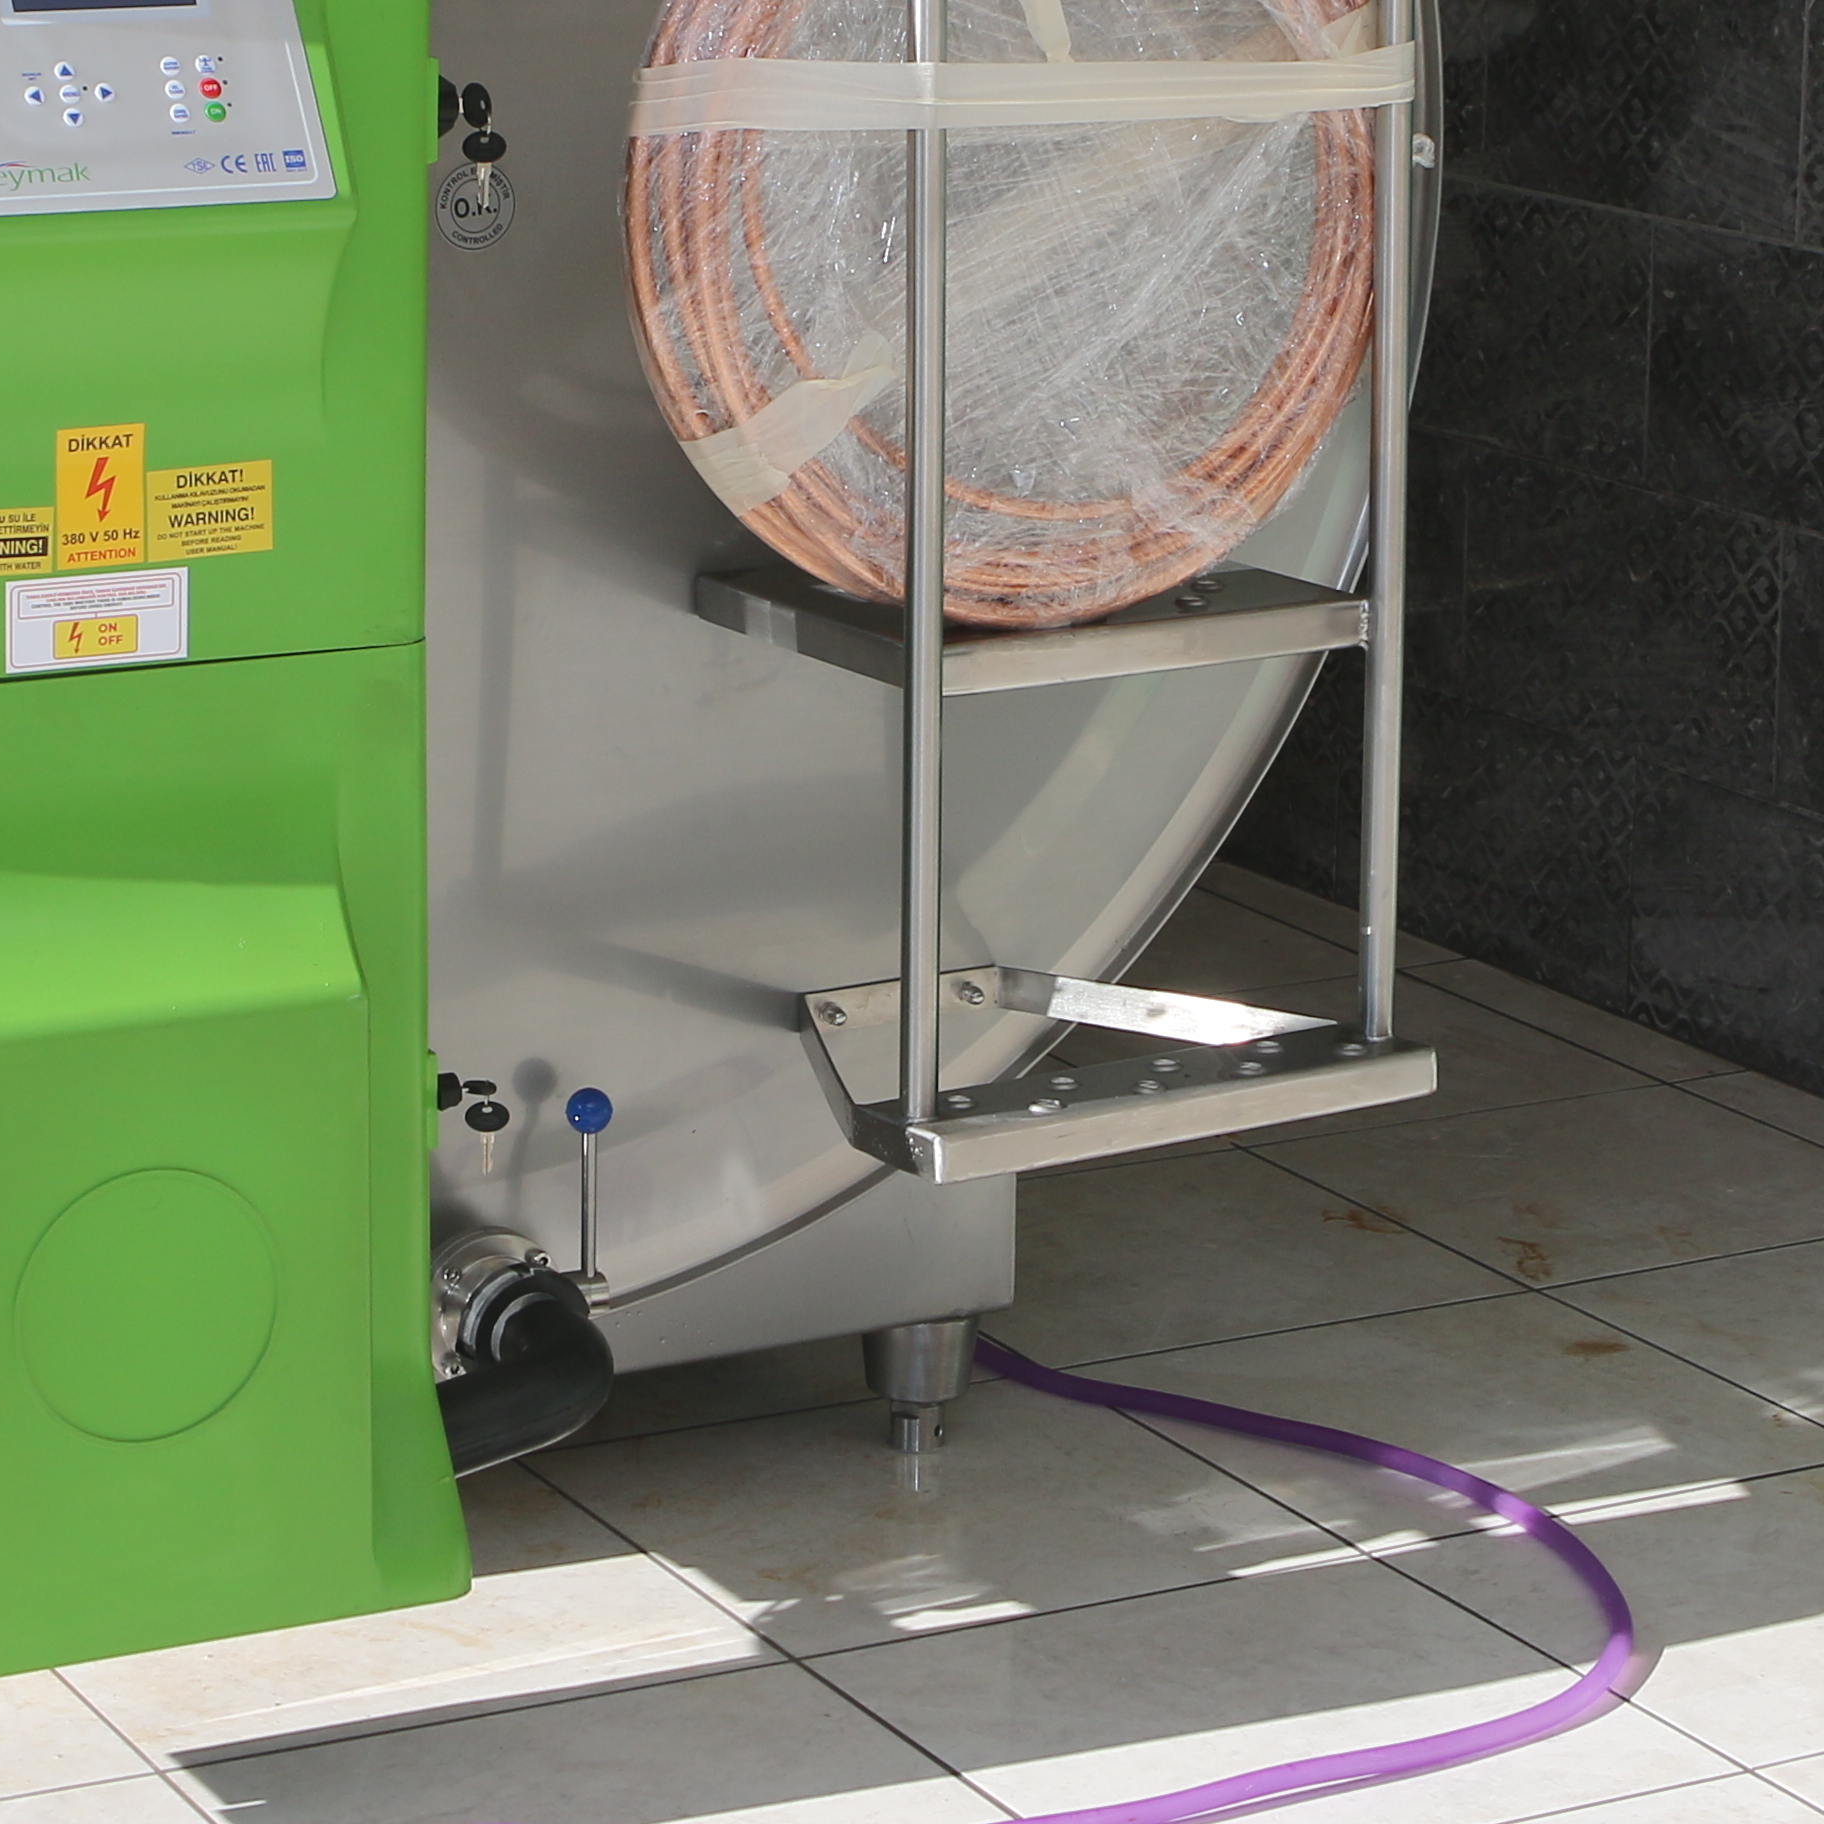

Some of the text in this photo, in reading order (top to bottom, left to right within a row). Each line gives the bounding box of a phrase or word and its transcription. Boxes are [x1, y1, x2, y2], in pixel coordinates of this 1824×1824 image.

[440, 168, 469, 210] KONTROL
[452, 223, 503, 244] CONTROLLED
[68, 433, 133, 453] DİKKAT
[176, 469, 244, 489] DİKKAT!
[8, 514, 20, 522] SU
[23, 512, 36, 521] İLE
[168, 507, 254, 528] WARNING!
[62, 528, 140, 546] 380 V 50 Hz
[67, 547, 136, 563] ATTENTION
[15, 561, 41, 571] WATER
[98, 622, 117, 633] ON
[98, 634, 124, 646] OFF
